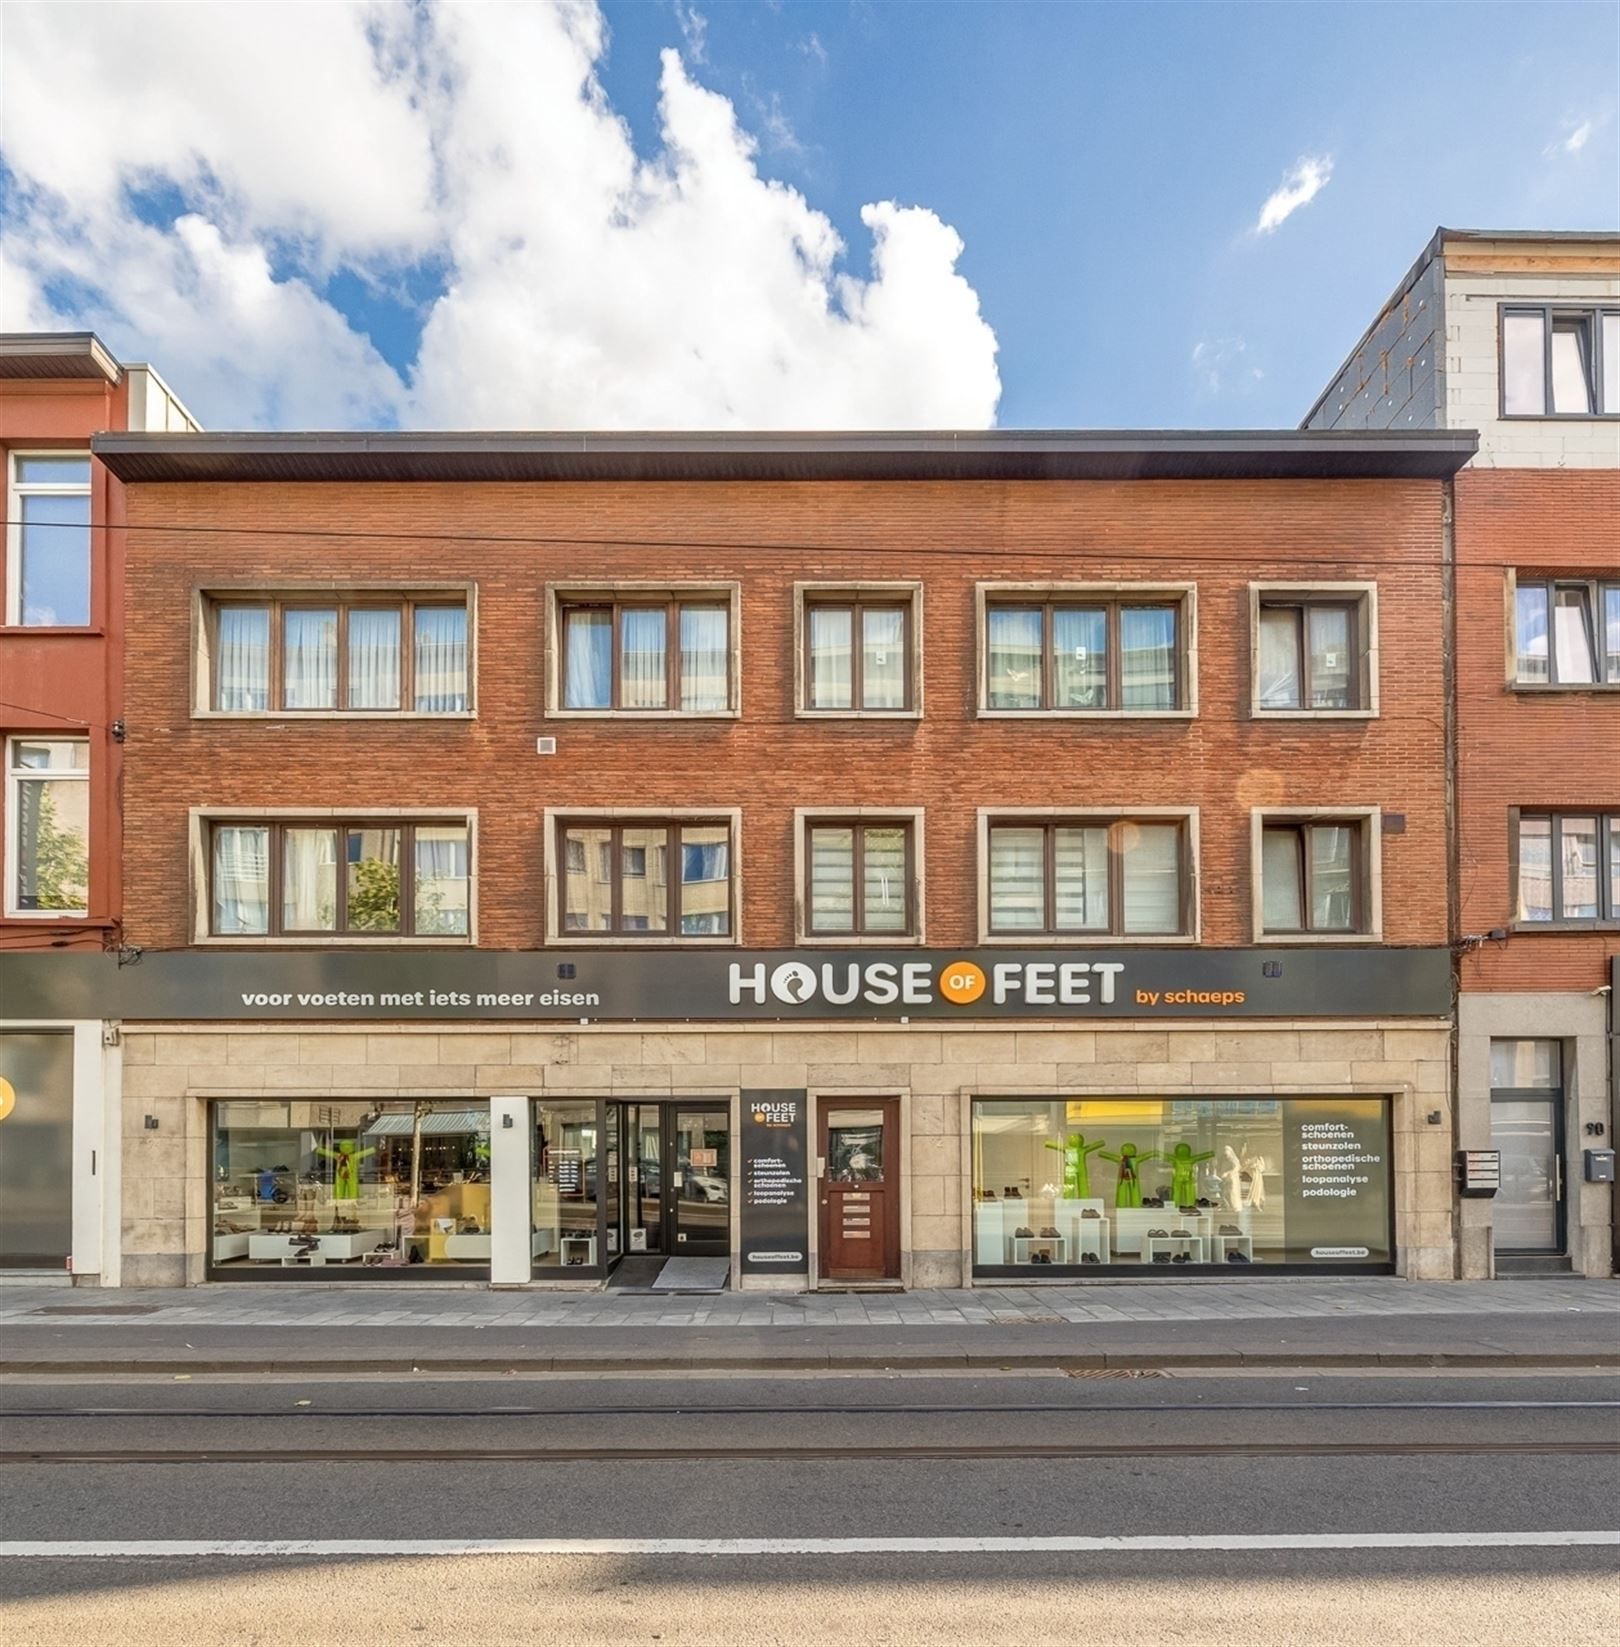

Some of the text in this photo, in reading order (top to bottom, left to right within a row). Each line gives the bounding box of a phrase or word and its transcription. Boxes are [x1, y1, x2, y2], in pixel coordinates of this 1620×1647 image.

[728, 962, 1246, 1006] HOUSE OF FEET by schaeps
[241, 989, 600, 1006] voor voeten met iets meer eisen
[751, 1102, 797, 1113] HOUSE
[766, 1112, 796, 1122] FEET
[1301, 1123, 1348, 1131] comfort-
[1586, 1122, 1604, 1136] 90
[1301, 1130, 1355, 1139] schoenen
[1301, 1142, 1361, 1150] steunzolen
[1301, 1153, 1381, 1164] orthopedische
[1302, 1162, 1355, 1170] schoenen
[1301, 1174, 1369, 1185] loopanalyse
[1302, 1187, 1357, 1197] podologie
